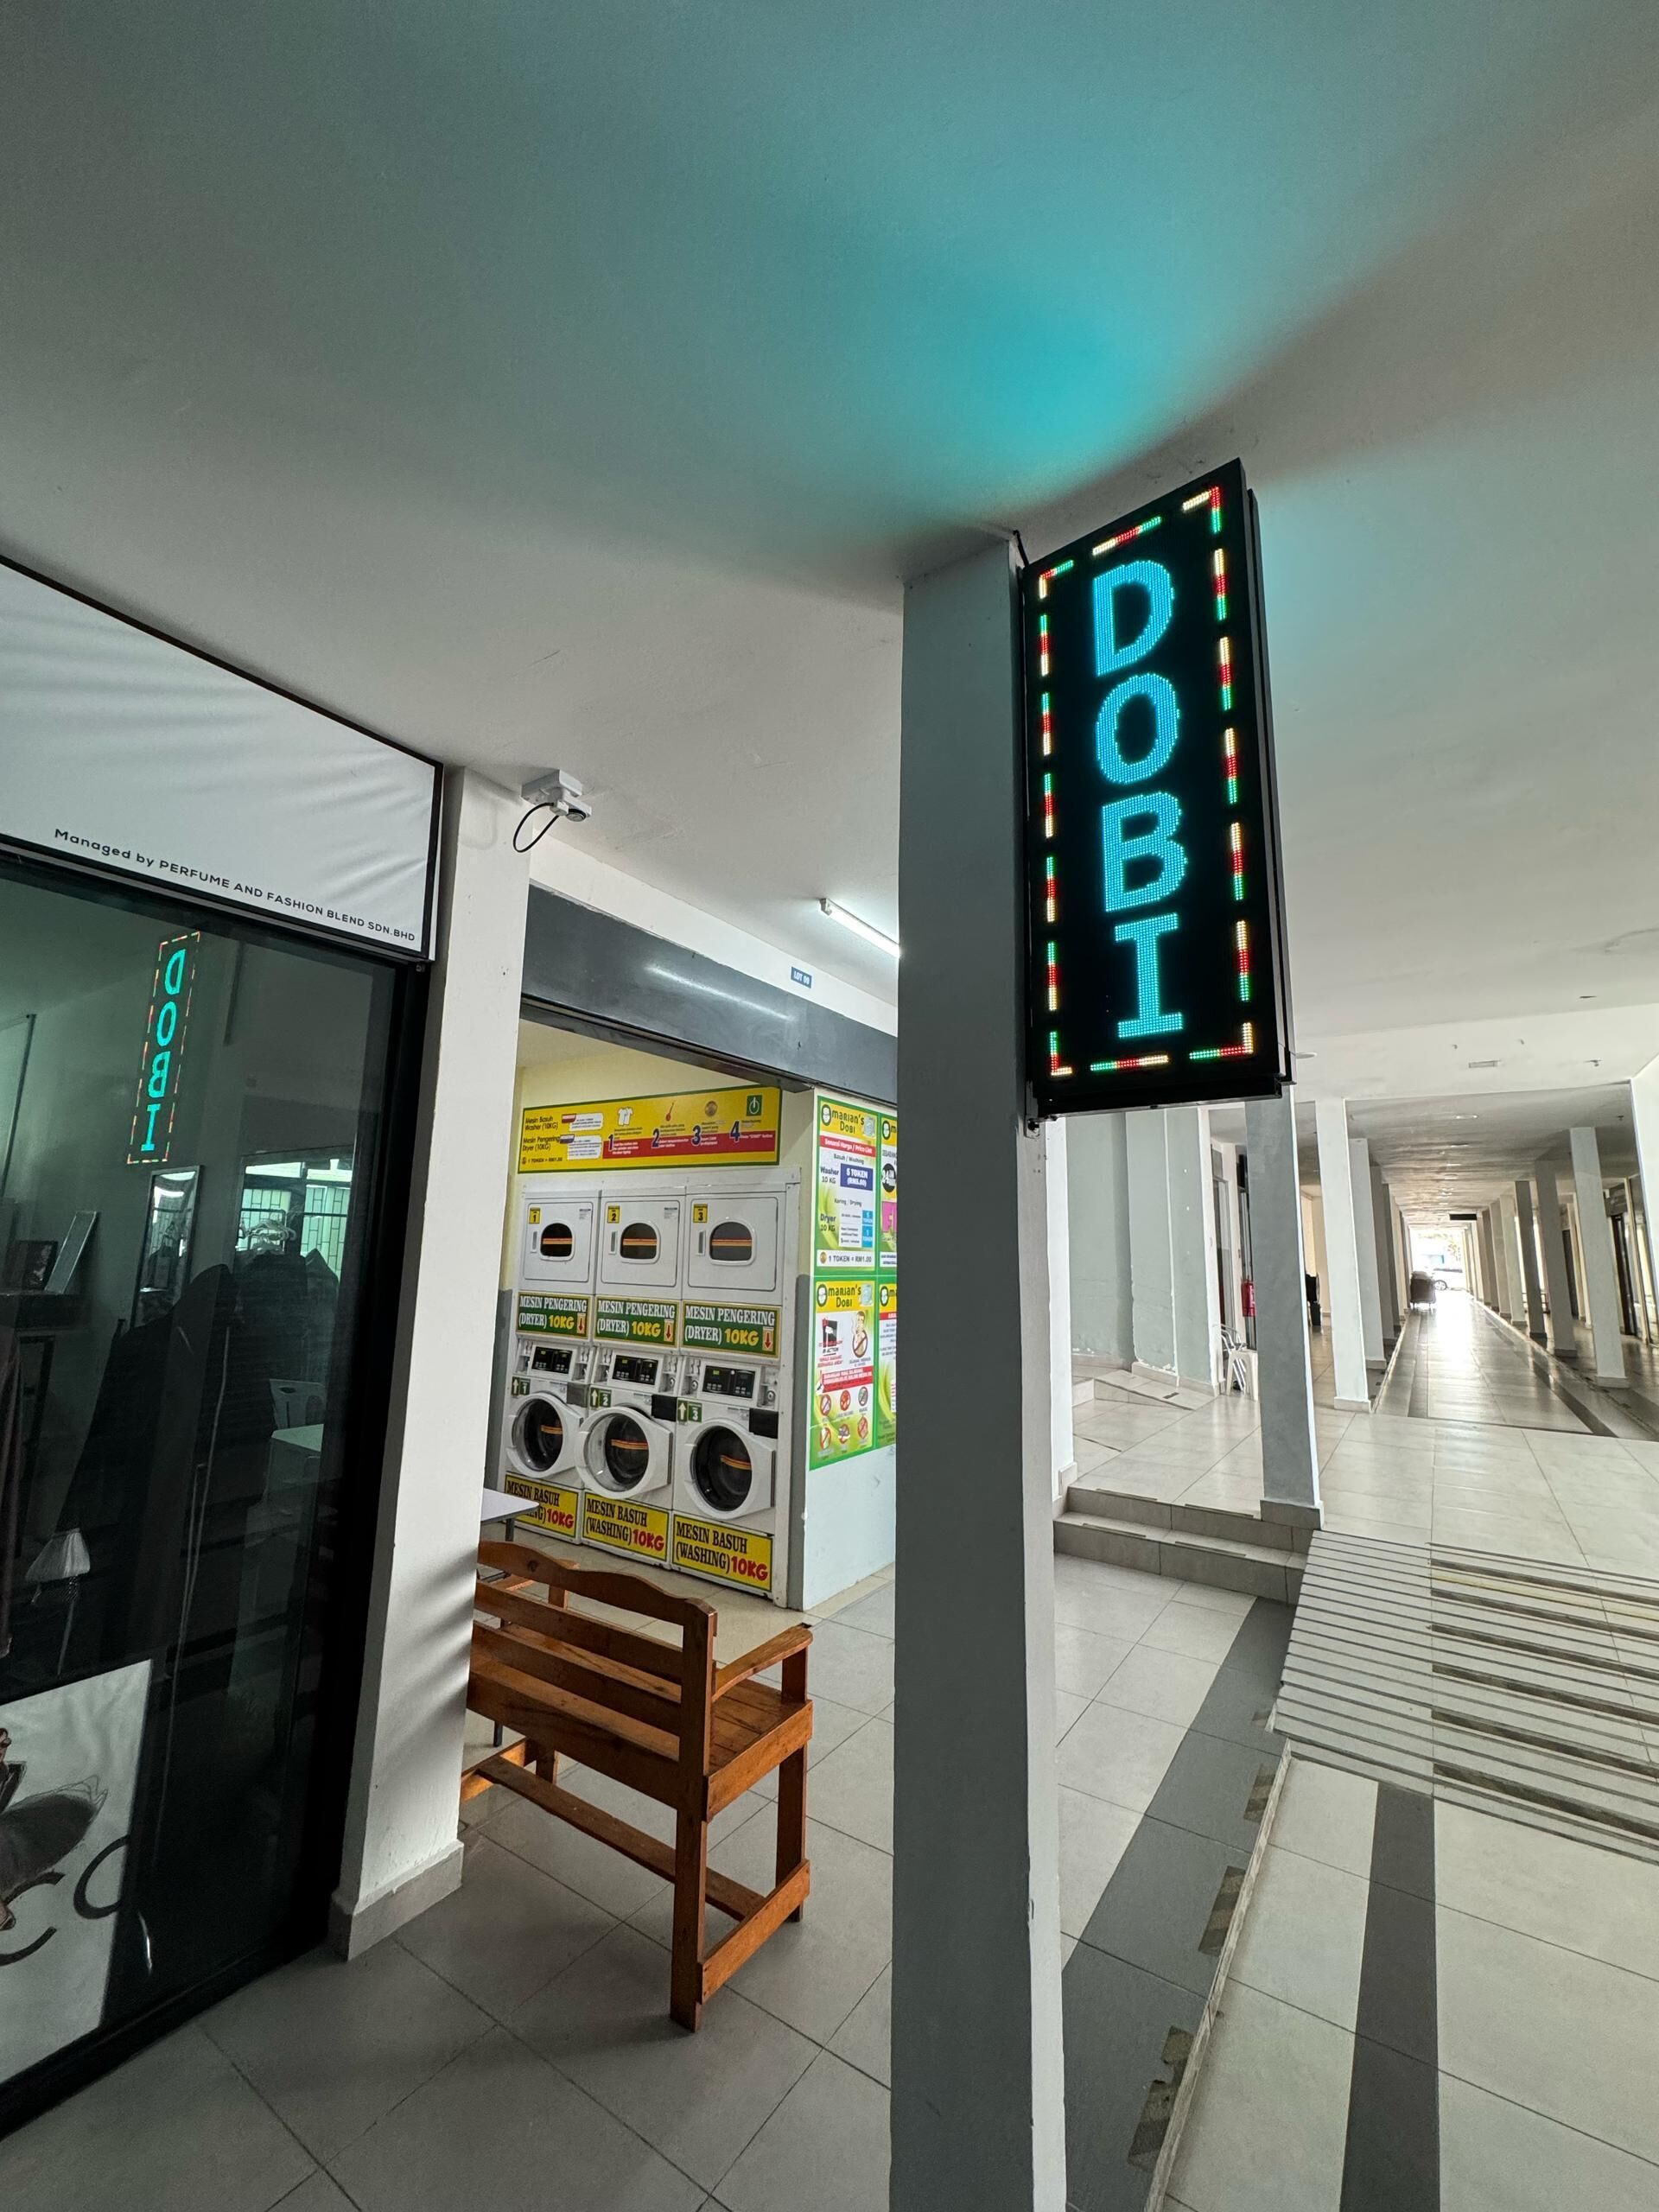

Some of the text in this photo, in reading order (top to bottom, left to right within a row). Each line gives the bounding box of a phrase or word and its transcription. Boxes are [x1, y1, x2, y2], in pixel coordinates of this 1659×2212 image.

[1092, 557, 1187, 1039] DOBI
[54, 829, 415, 941] Managed by PERFUME AND FASHION BLEND SDN.BHD
[652, 1128, 660, 1147] 2
[692, 1125, 701, 1145] 3
[730, 1121, 741, 1141] 4
[608, 1134, 614, 1151] 1
[820, 1166, 839, 1176] Washer
[820, 1213, 836, 1223] Dryer
[520, 1296, 587, 1313] MESIN PENGERING
[598, 1300, 676, 1319] MESIN PENGERING
[518, 1313, 575, 1329] (DRYER) 10KG
[685, 1305, 775, 1326] MESIN PENGERING
[597, 1319, 661, 1338] (DRYER) 10KG
[684, 1325, 760, 1346] (DRYER) 10KG
[507, 1481, 560, 1507] MESIN BASUH
[547, 1509, 574, 1529] 10KG
[587, 1498, 647, 1528] MESIN BASUH
[586, 1516, 664, 1551] (WASHING) 10KG
[677, 1521, 747, 1554] MESIN BASUH
[676, 1541, 768, 1581] (WASHING) 10KG
